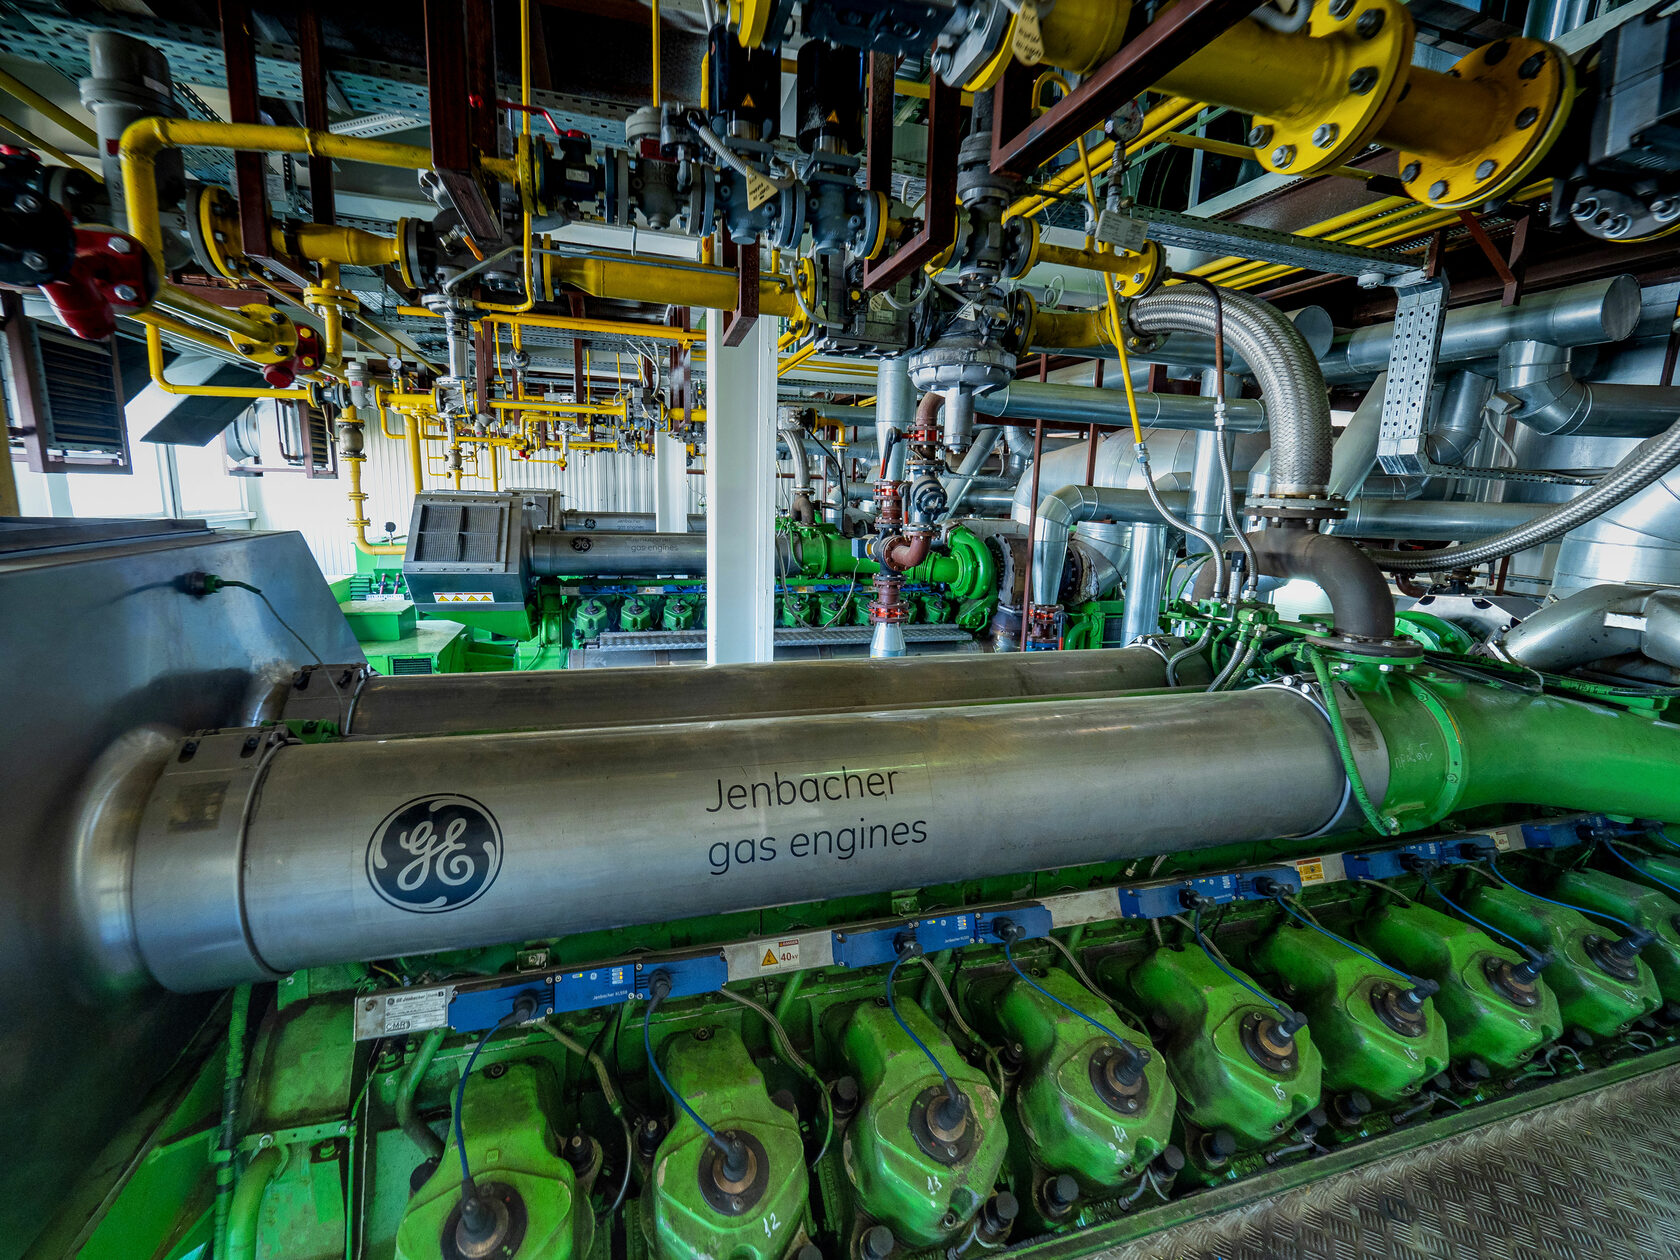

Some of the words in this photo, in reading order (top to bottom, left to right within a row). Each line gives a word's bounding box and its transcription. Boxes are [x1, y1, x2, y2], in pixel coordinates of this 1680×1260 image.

[630, 544, 646, 553] gas
[647, 542, 679, 553] engines
[706, 766, 899, 813] Jenbacher
[708, 834, 777, 876] gas
[790, 817, 928, 861] engines
[763, 1211, 782, 1239] 12
